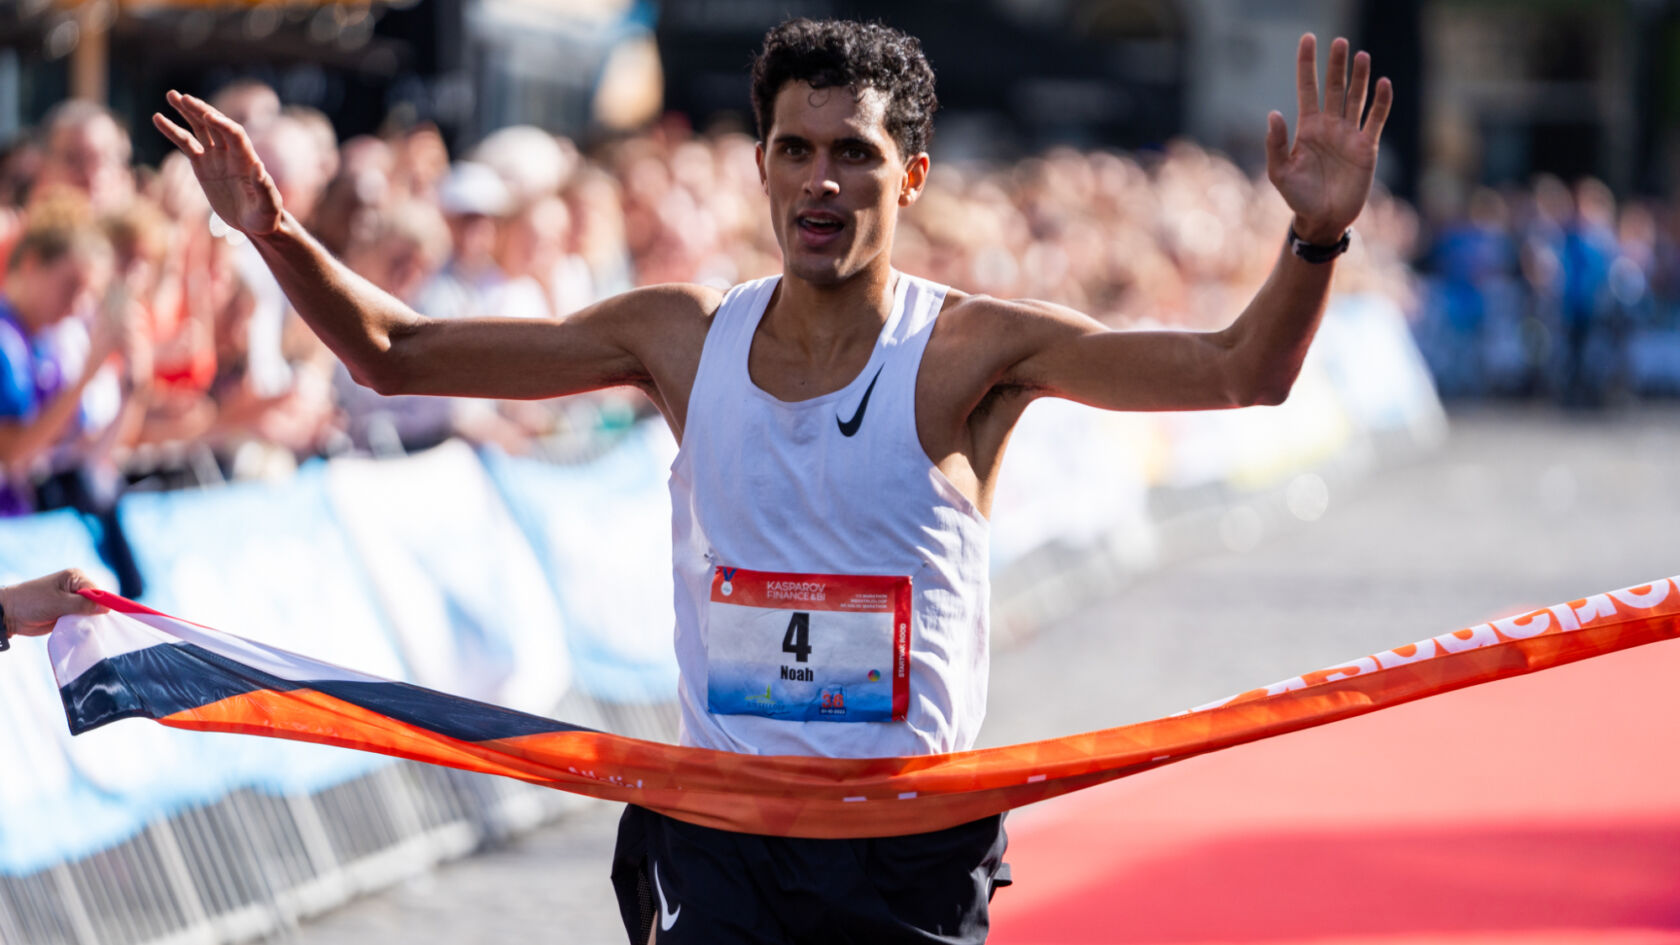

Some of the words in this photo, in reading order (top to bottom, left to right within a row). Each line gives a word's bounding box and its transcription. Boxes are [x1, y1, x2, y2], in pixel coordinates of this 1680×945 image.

[767, 581, 826, 592] KASPAROV
[767, 590, 809, 601] FINANCE
[782, 612, 812, 662] 4
[899, 623, 907, 643] ROOD
[781, 665, 814, 682] Noah
